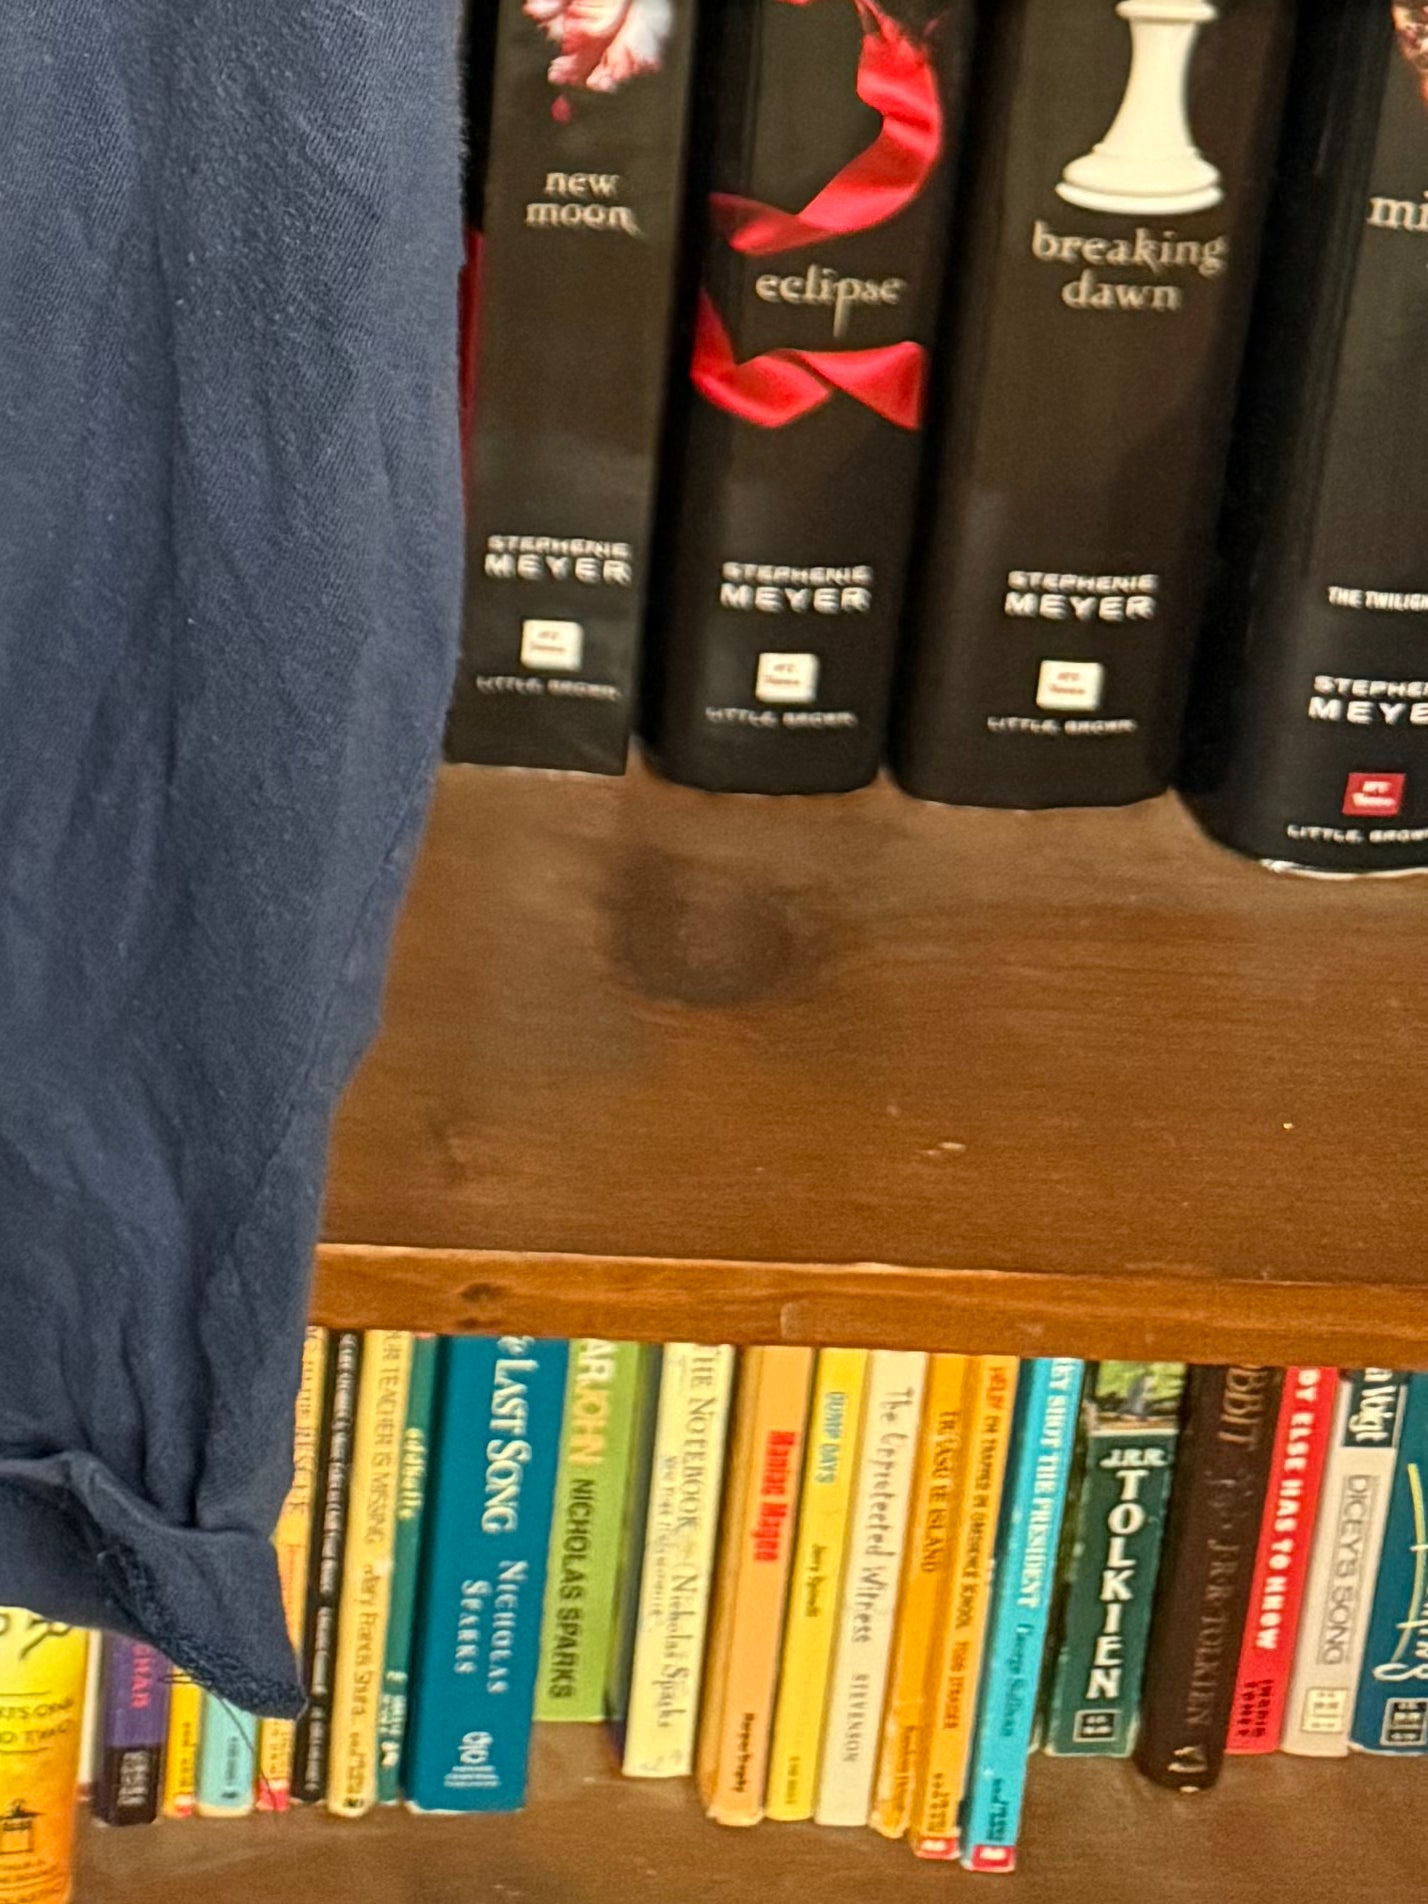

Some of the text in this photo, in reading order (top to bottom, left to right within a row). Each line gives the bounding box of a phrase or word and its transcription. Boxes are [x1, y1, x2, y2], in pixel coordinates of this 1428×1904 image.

[545, 169, 620, 197] new
[526, 200, 637, 234] moon
[1032, 220, 1228, 276] breaking
[755, 265, 905, 338] eclipse
[1061, 277, 1182, 311] dawn
[484, 553, 632, 586] MEYER
[487, 535, 631, 558] STEPHENIE
[722, 562, 872, 585] STEPHENIE
[721, 583, 871, 613] MEYER
[1004, 591, 1157, 621] MEYER
[1009, 570, 1158, 592] STEPHENIE
[1328, 586, 1362, 607] THE
[1309, 696, 1428, 725] MEYE
[481, 1357, 539, 1535] LAST SONG
[815, 1390, 848, 1484] DUMP DAYS
[1039, 1395, 1067, 1448] SHOT
[1284, 1411, 1316, 1472] ELSE
[1348, 1388, 1397, 1443] Voigt
[365, 1367, 401, 1546] TEACHER MISSING
[673, 1395, 717, 1534] NOTEBOOK
[1033, 1452, 1061, 1495] THE
[752, 1430, 796, 1564] Maniac Magee
[1274, 1479, 1303, 1533] HAS
[922, 1506, 950, 1574] ISLAND
[1017, 1497, 1055, 1608] PRESIDENT
[1267, 1539, 1294, 1570] TO
[1323, 1473, 1373, 1666] DICEY'S SONG
[547, 1478, 596, 1702] NICHOLAS SPARKS
[844, 1386, 914, 1763] The Unprotected Witness STEVENSON
[1086, 1469, 1146, 1701] TOLKIEN
[455, 1580, 491, 1675] SPARKS
[488, 1559, 529, 1694] NICHOLAS
[667, 1572, 701, 1665] Nicholas
[1255, 1575, 1288, 1650] KNOW
[1009, 1622, 1035, 1674] George
[657, 1667, 691, 1730] Sparks
[1001, 1677, 1026, 1739] Sullivan
